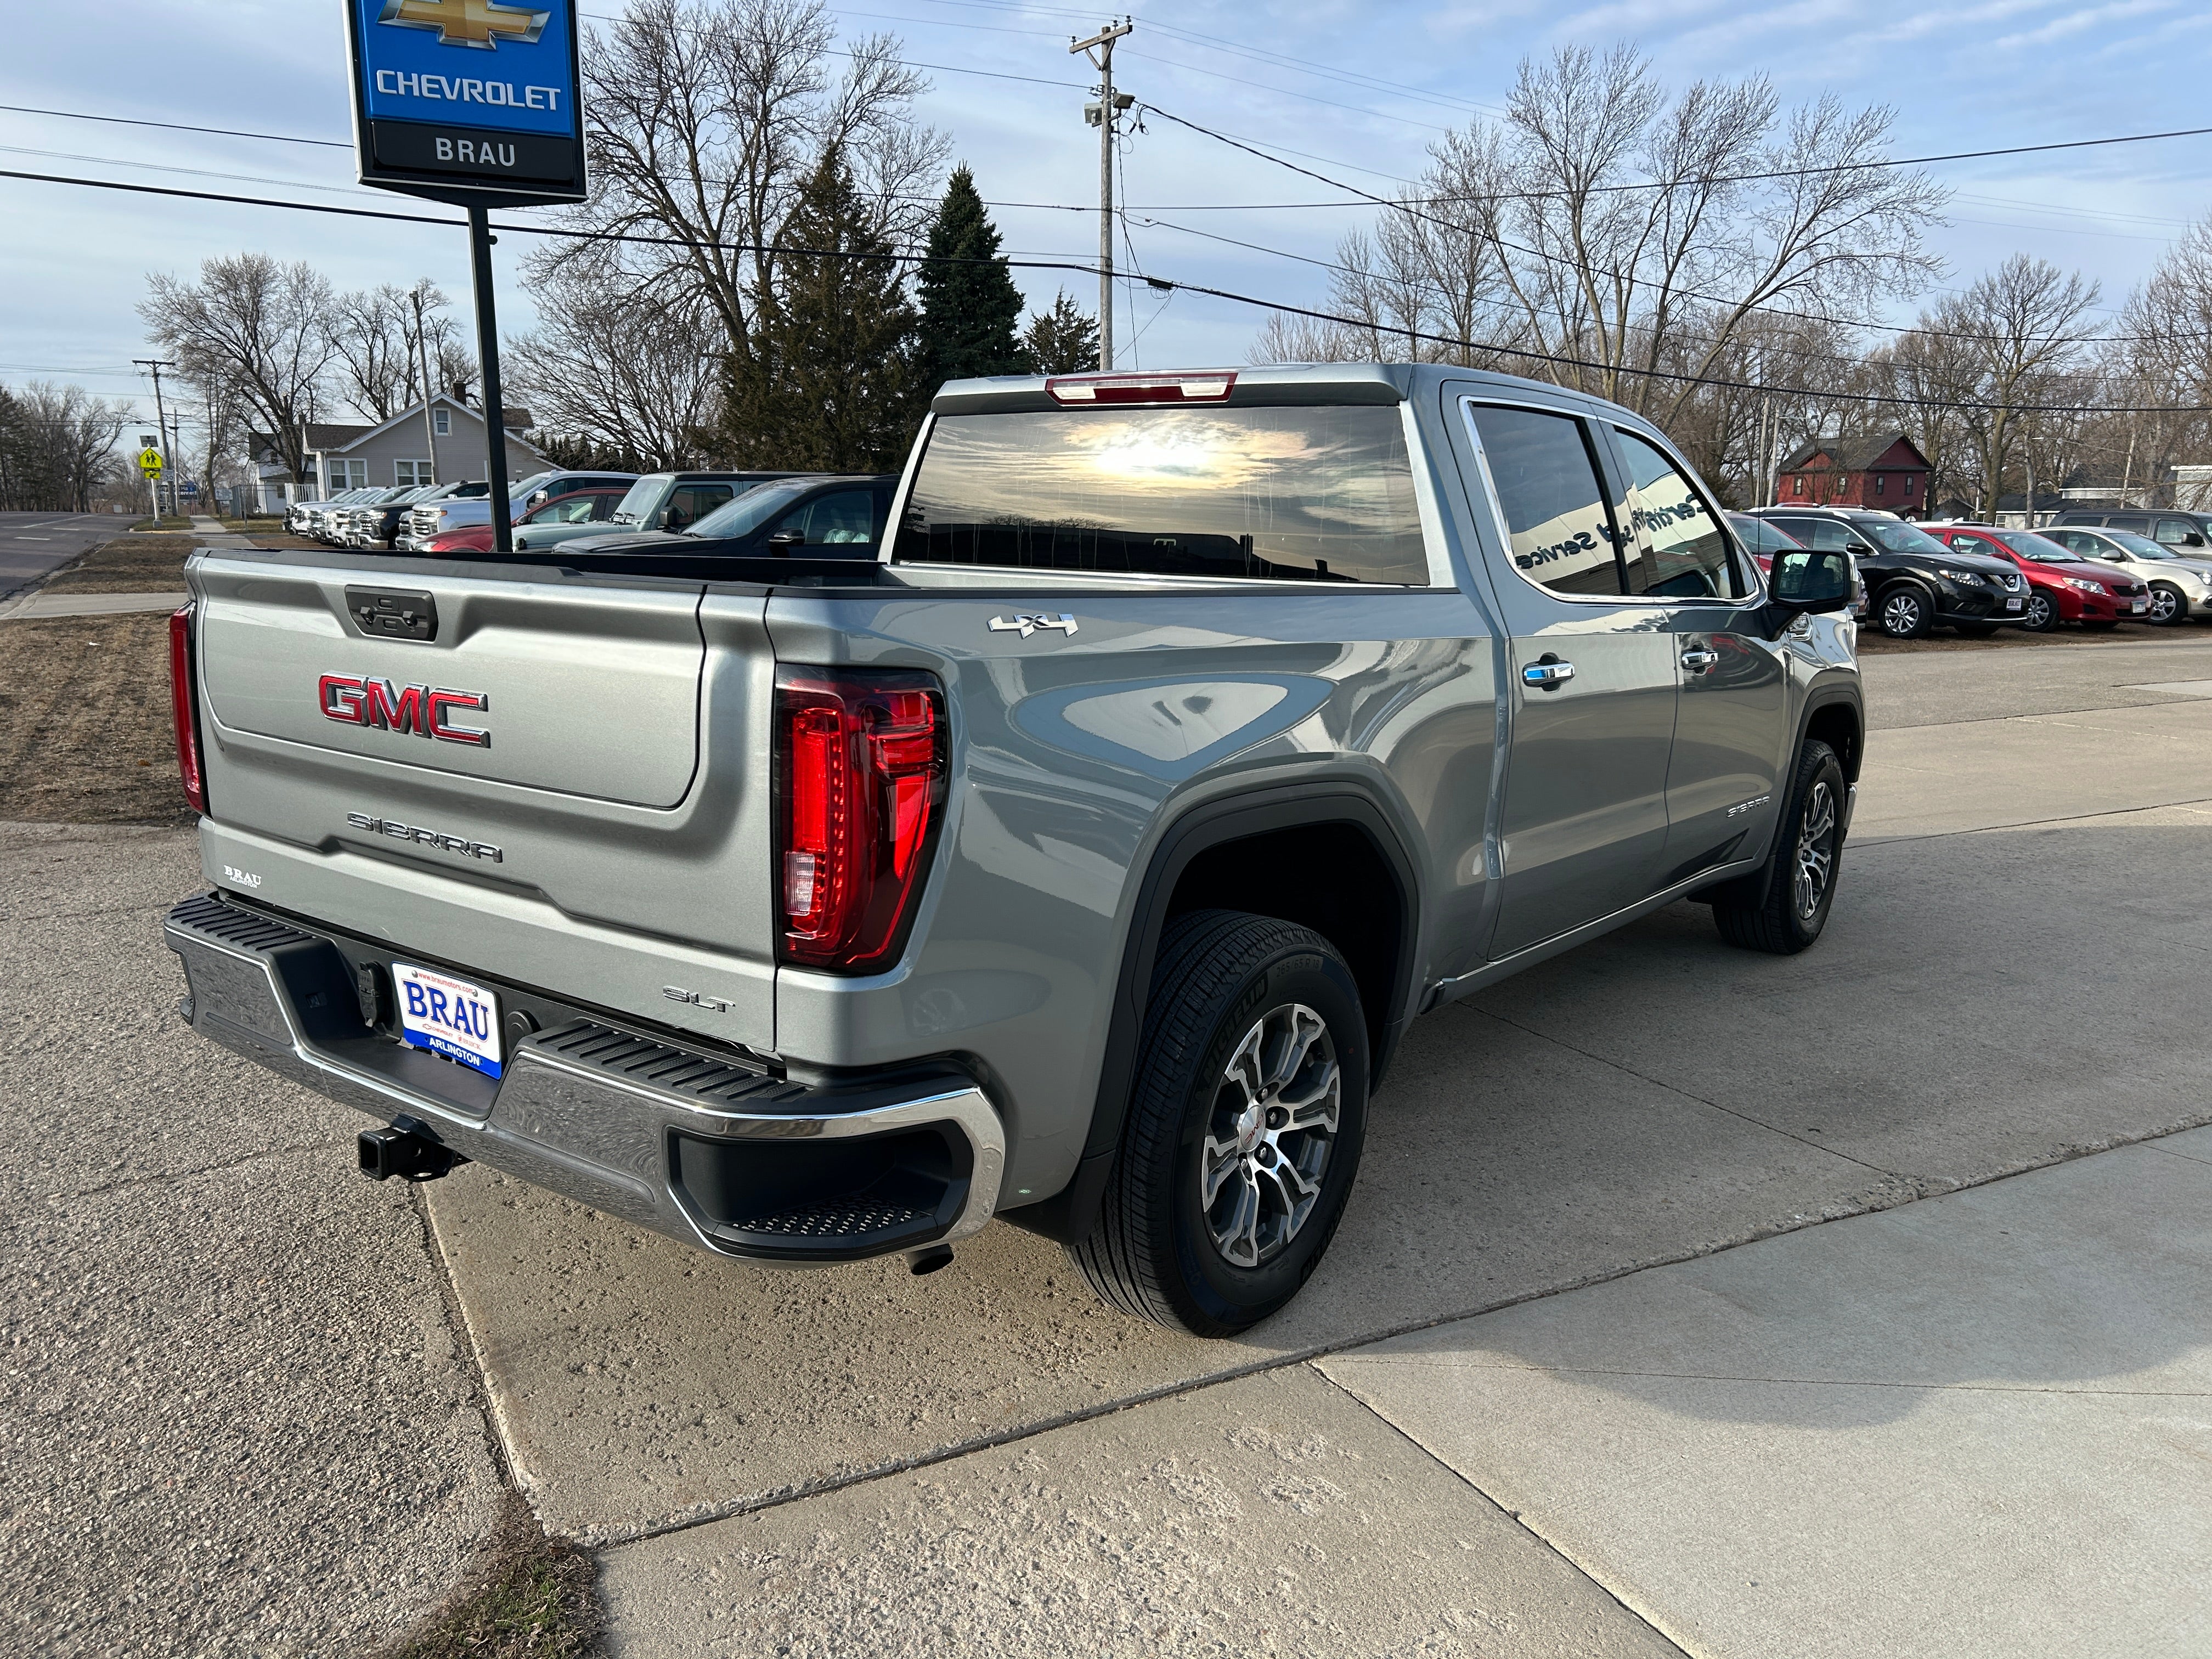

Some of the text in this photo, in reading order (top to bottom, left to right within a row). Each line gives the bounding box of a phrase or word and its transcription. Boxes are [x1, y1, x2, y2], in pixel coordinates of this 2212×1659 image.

[376, 70, 561, 111] CHEVROLET
[435, 137, 516, 167] BRAU
[318, 670, 492, 749] GMC
[347, 811, 503, 864] SIERRA
[224, 865, 262, 885] BRAU
[402, 979, 489, 1042] BRAU
[662, 985, 736, 1013] SLT
[432, 1026, 453, 1037] CHEVROLET
[462, 1038, 482, 1050] BUICK
[429, 1037, 480, 1066] ARLINGTON
